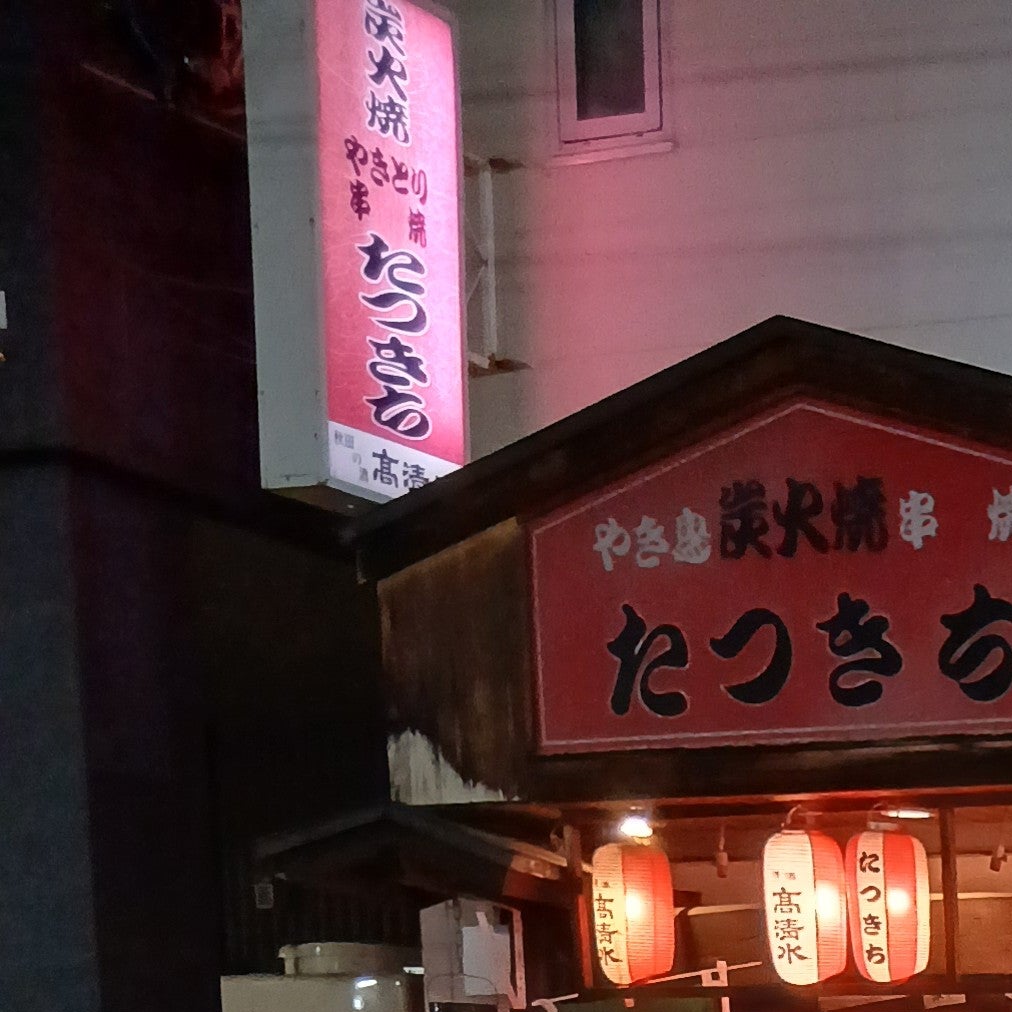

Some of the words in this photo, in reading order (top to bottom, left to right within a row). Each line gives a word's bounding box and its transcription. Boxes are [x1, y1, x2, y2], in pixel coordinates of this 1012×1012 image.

[344, 134, 428, 206] やきとり
[356, 231, 432, 441] たつきち
[719, 475, 889, 560] 炭火焼
[900, 490, 937, 550] 串
[859, 851, 885, 964] たつきち
